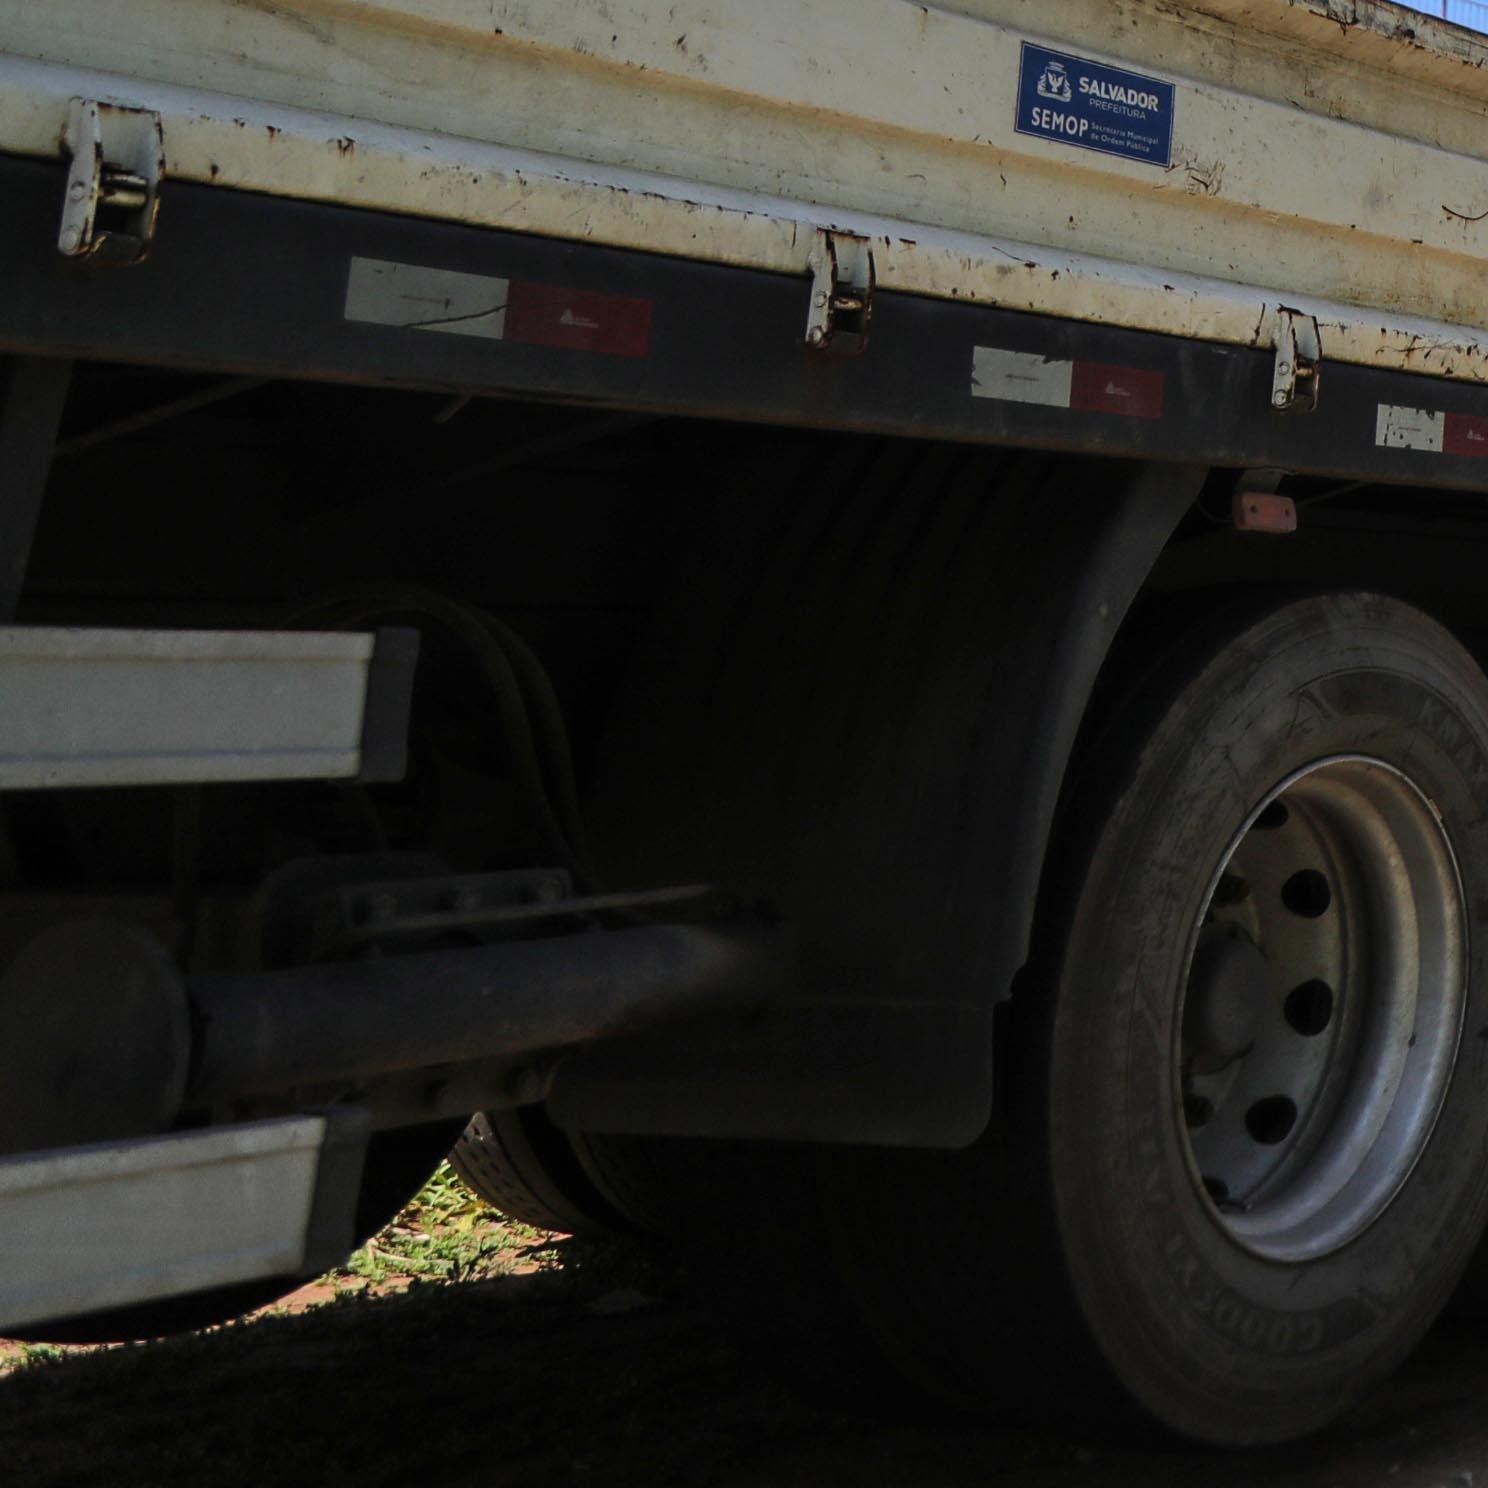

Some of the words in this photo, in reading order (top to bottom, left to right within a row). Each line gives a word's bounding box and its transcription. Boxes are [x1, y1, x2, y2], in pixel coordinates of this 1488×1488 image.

[1078, 76, 1159, 112] SALVADOR
[1089, 97, 1147, 121] PREFEITURA
[1031, 106, 1089, 137] SEMOP
